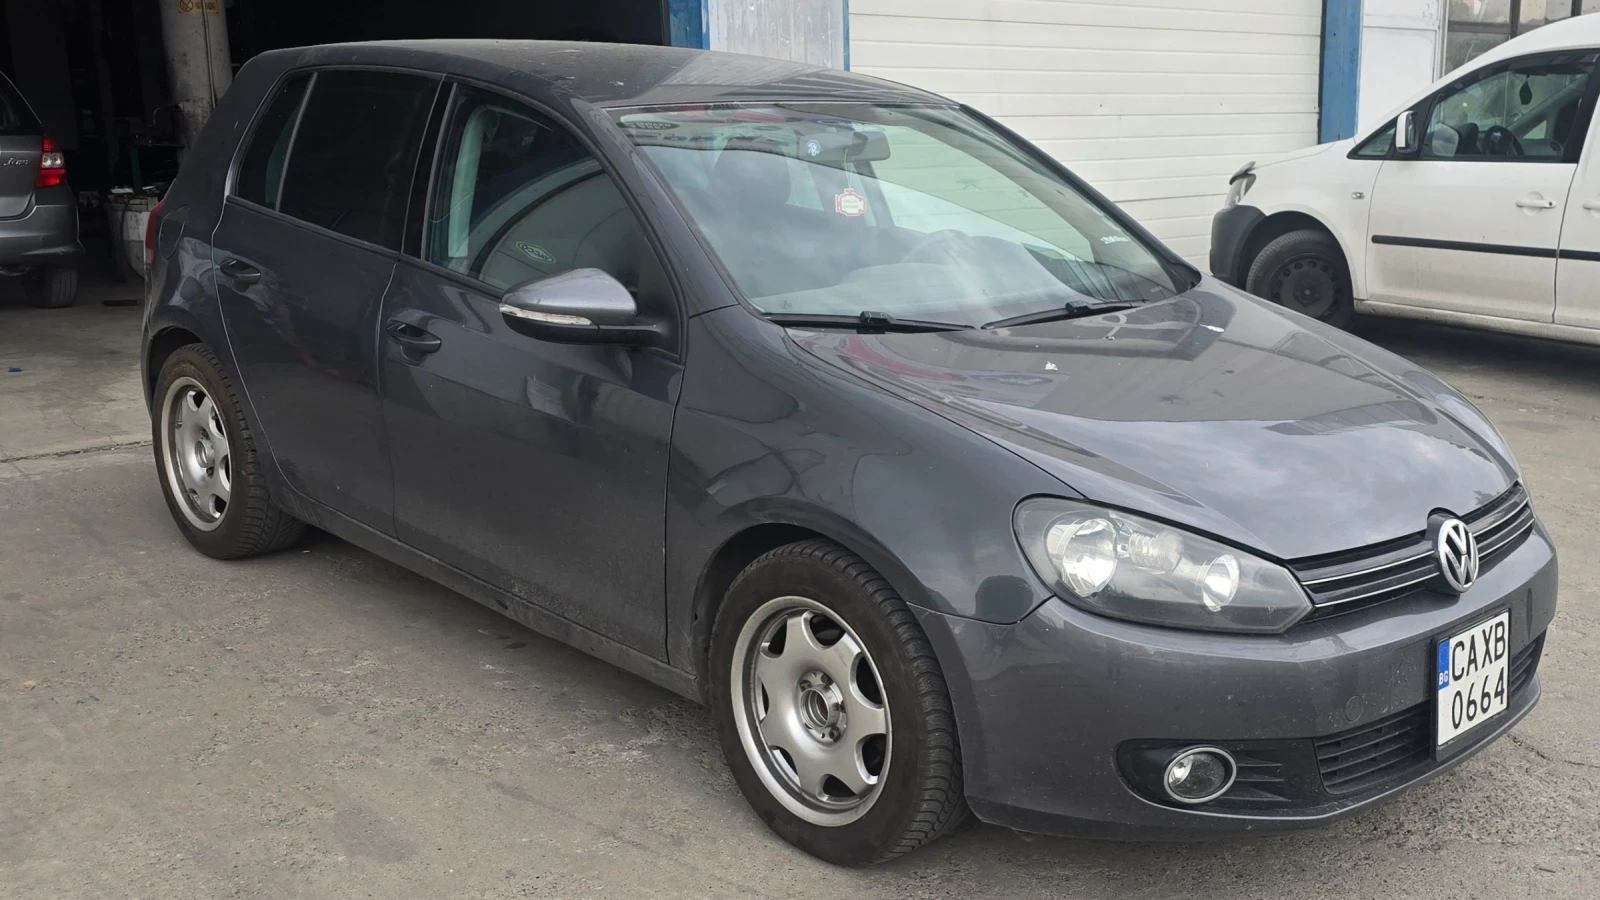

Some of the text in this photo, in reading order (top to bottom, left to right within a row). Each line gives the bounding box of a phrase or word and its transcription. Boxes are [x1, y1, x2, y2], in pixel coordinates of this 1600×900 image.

[1438, 670, 1449, 685] BG
[1451, 620, 1506, 682] CAXB
[1452, 666, 1505, 729] 0664
